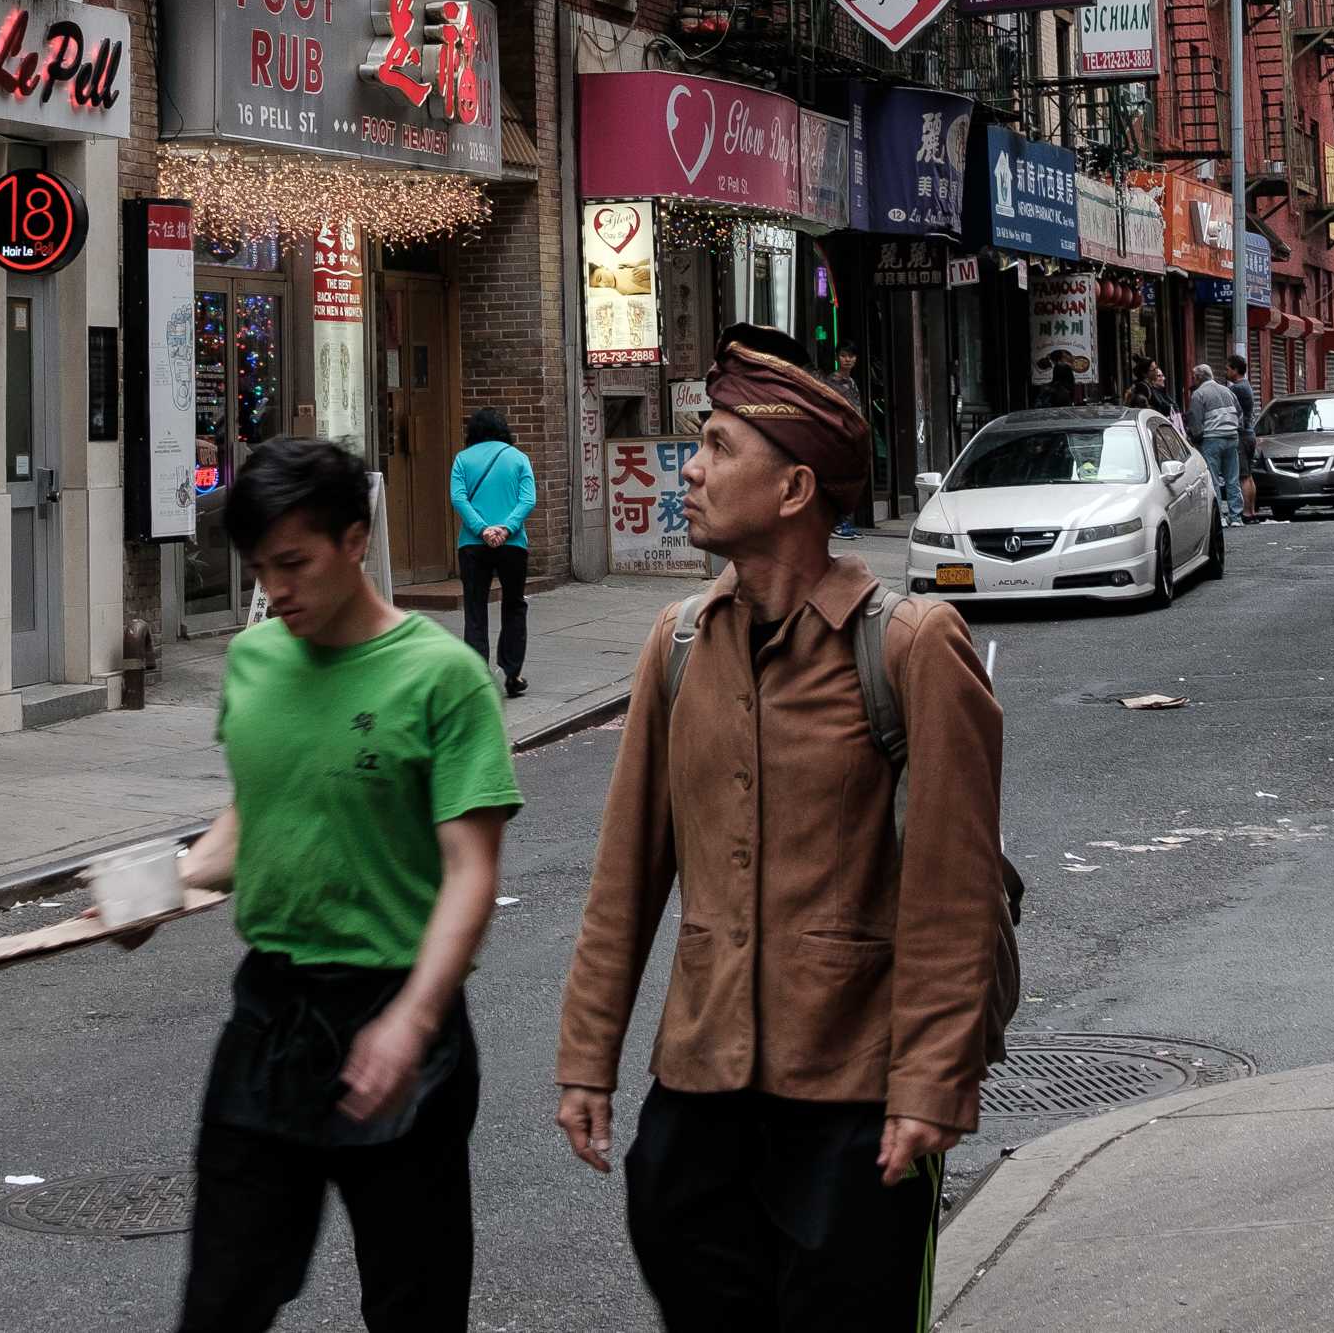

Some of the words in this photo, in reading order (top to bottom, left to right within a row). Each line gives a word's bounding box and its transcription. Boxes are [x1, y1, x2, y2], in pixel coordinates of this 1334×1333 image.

[1084, 2, 1151, 34] SICHUAN
[42, 21, 122, 109] Pell
[251, 28, 324, 95] RUB
[238, 103, 254, 126] 16
[260, 106, 293, 133] PELL
[299, 111, 318, 135] ST.
[724, 99, 765, 156] Glow
[361, 116, 396, 146] FOOT
[401, 123, 448, 156] HEAVEN
[718, 177, 726, 191] 12
[12, 175, 55, 242] 18
[2, 246, 22, 257] Hair
[23, 246, 34, 257] Le
[326, 278, 338, 290] THE
[338, 279, 352, 291] BEST
[1034, 280, 1086, 298] FAMOUS
[315, 305, 326, 316] FOR
[327, 305, 339, 316] MEN
[344, 306, 364, 318] WOMEN
[1039, 320, 1084, 337] 川外川
[676, 383, 702, 408] Glow
[581, 373, 601, 502] 天河印務
[611, 444, 657, 534] 天河
[661, 535, 691, 548] PRINT
